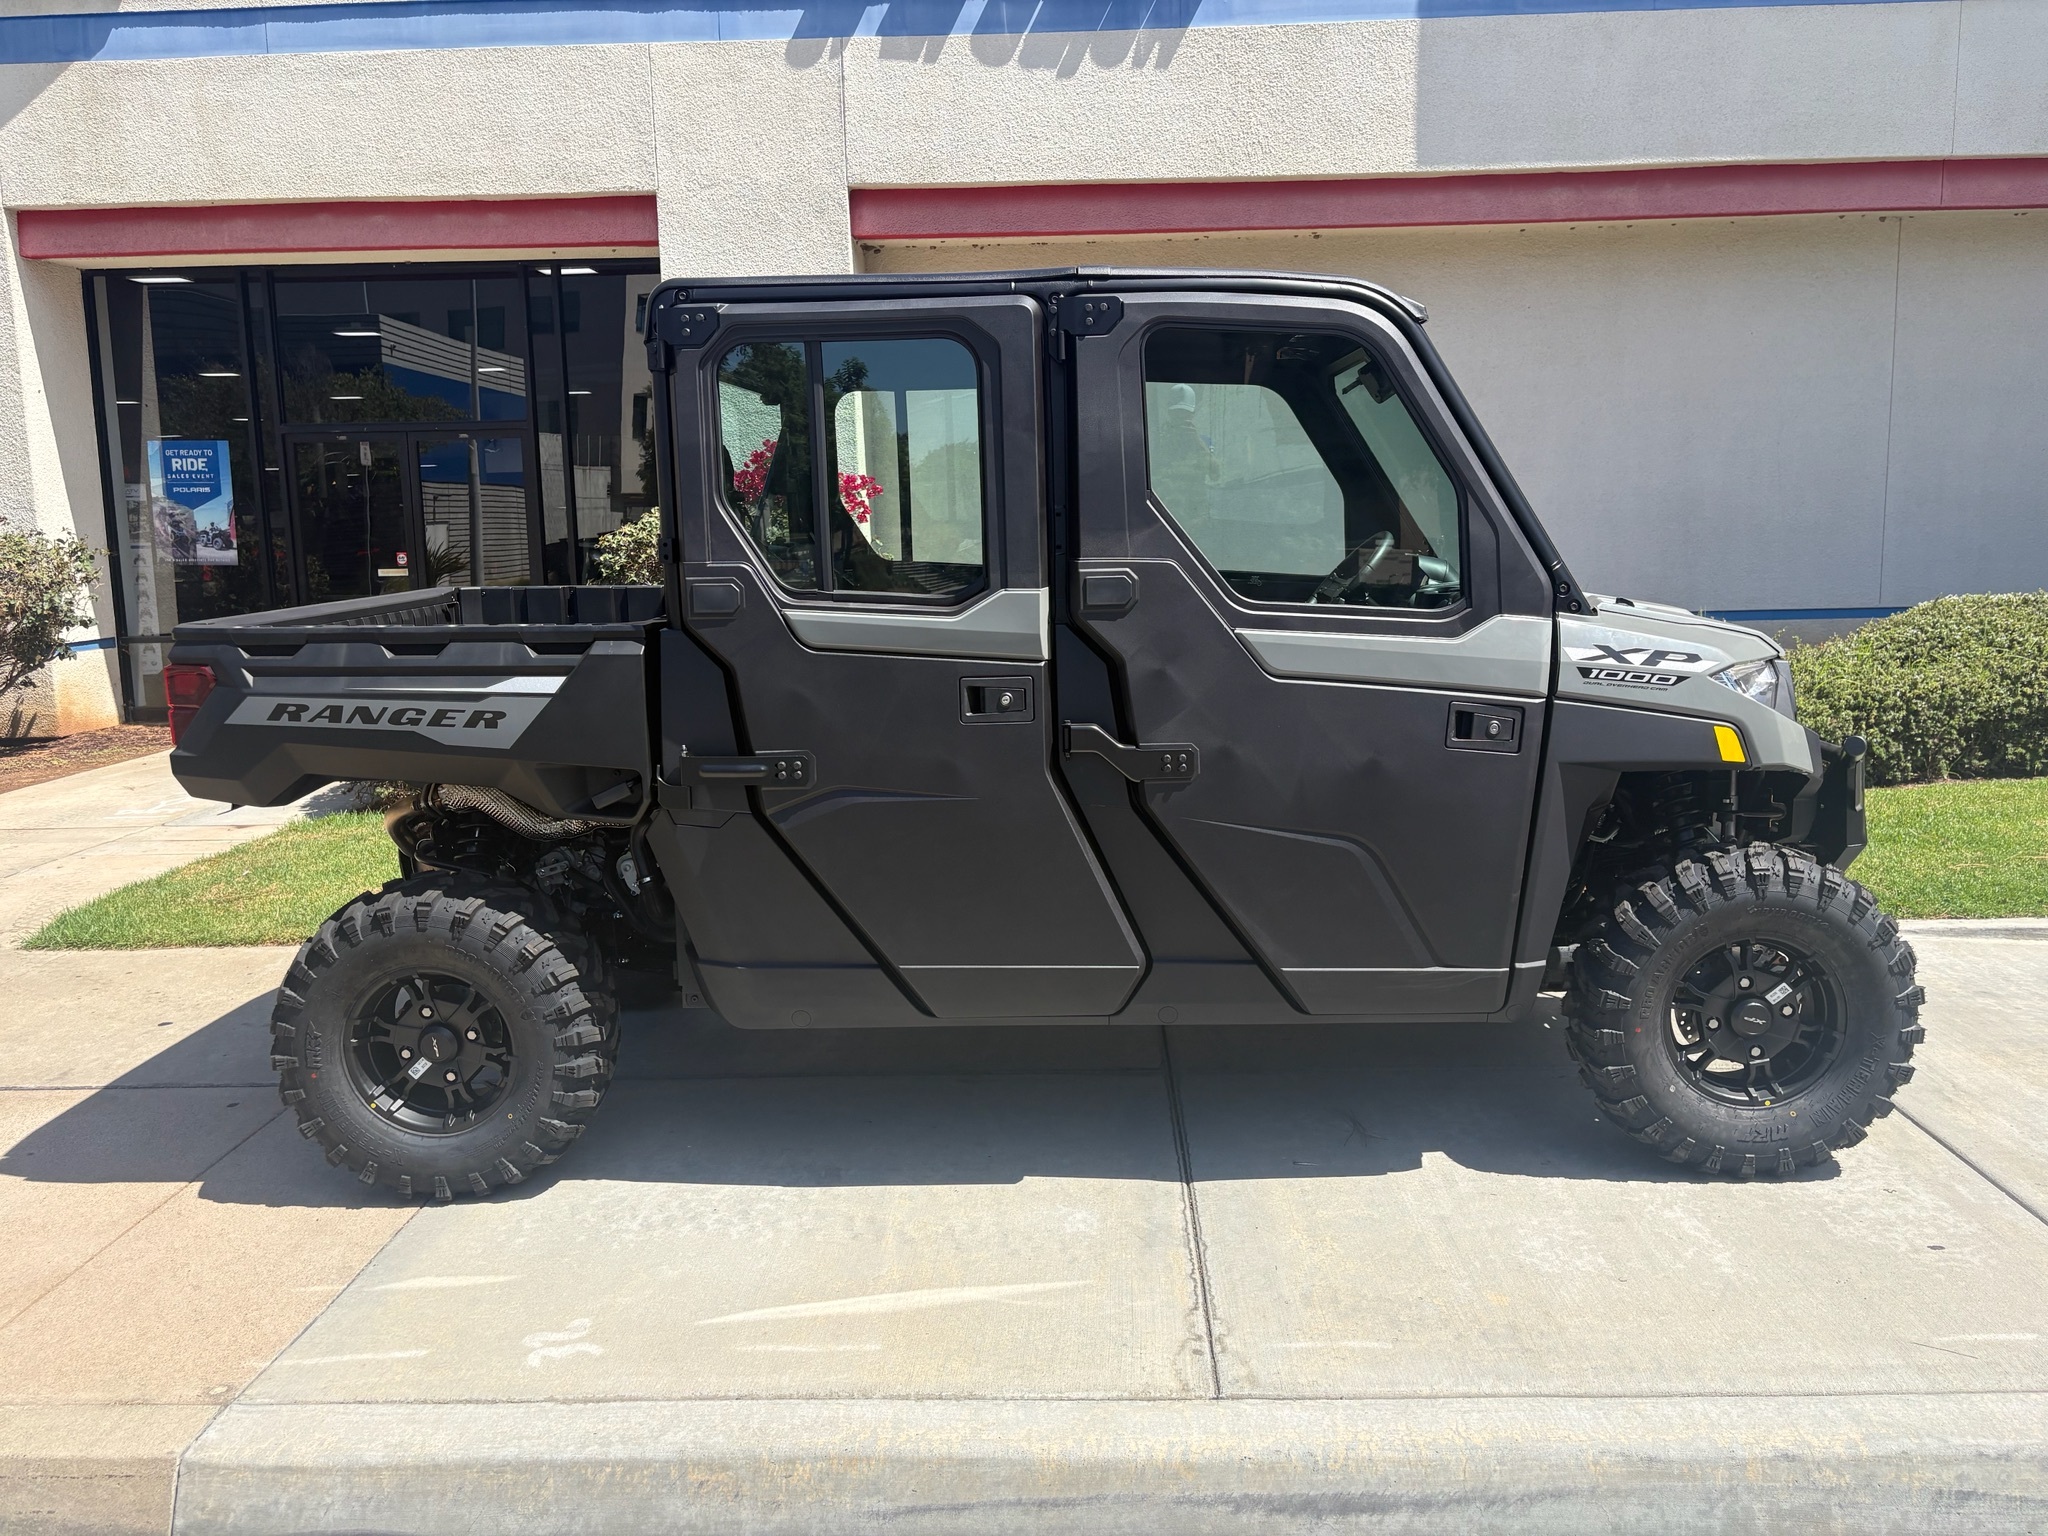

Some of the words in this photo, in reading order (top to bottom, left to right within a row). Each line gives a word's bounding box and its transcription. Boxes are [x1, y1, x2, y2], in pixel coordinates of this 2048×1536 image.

[1577, 644, 1703, 667] XP
[1588, 668, 1679, 685] 1000
[1606, 682, 1649, 690] OVERHEAD
[266, 703, 508, 730] RANGER
